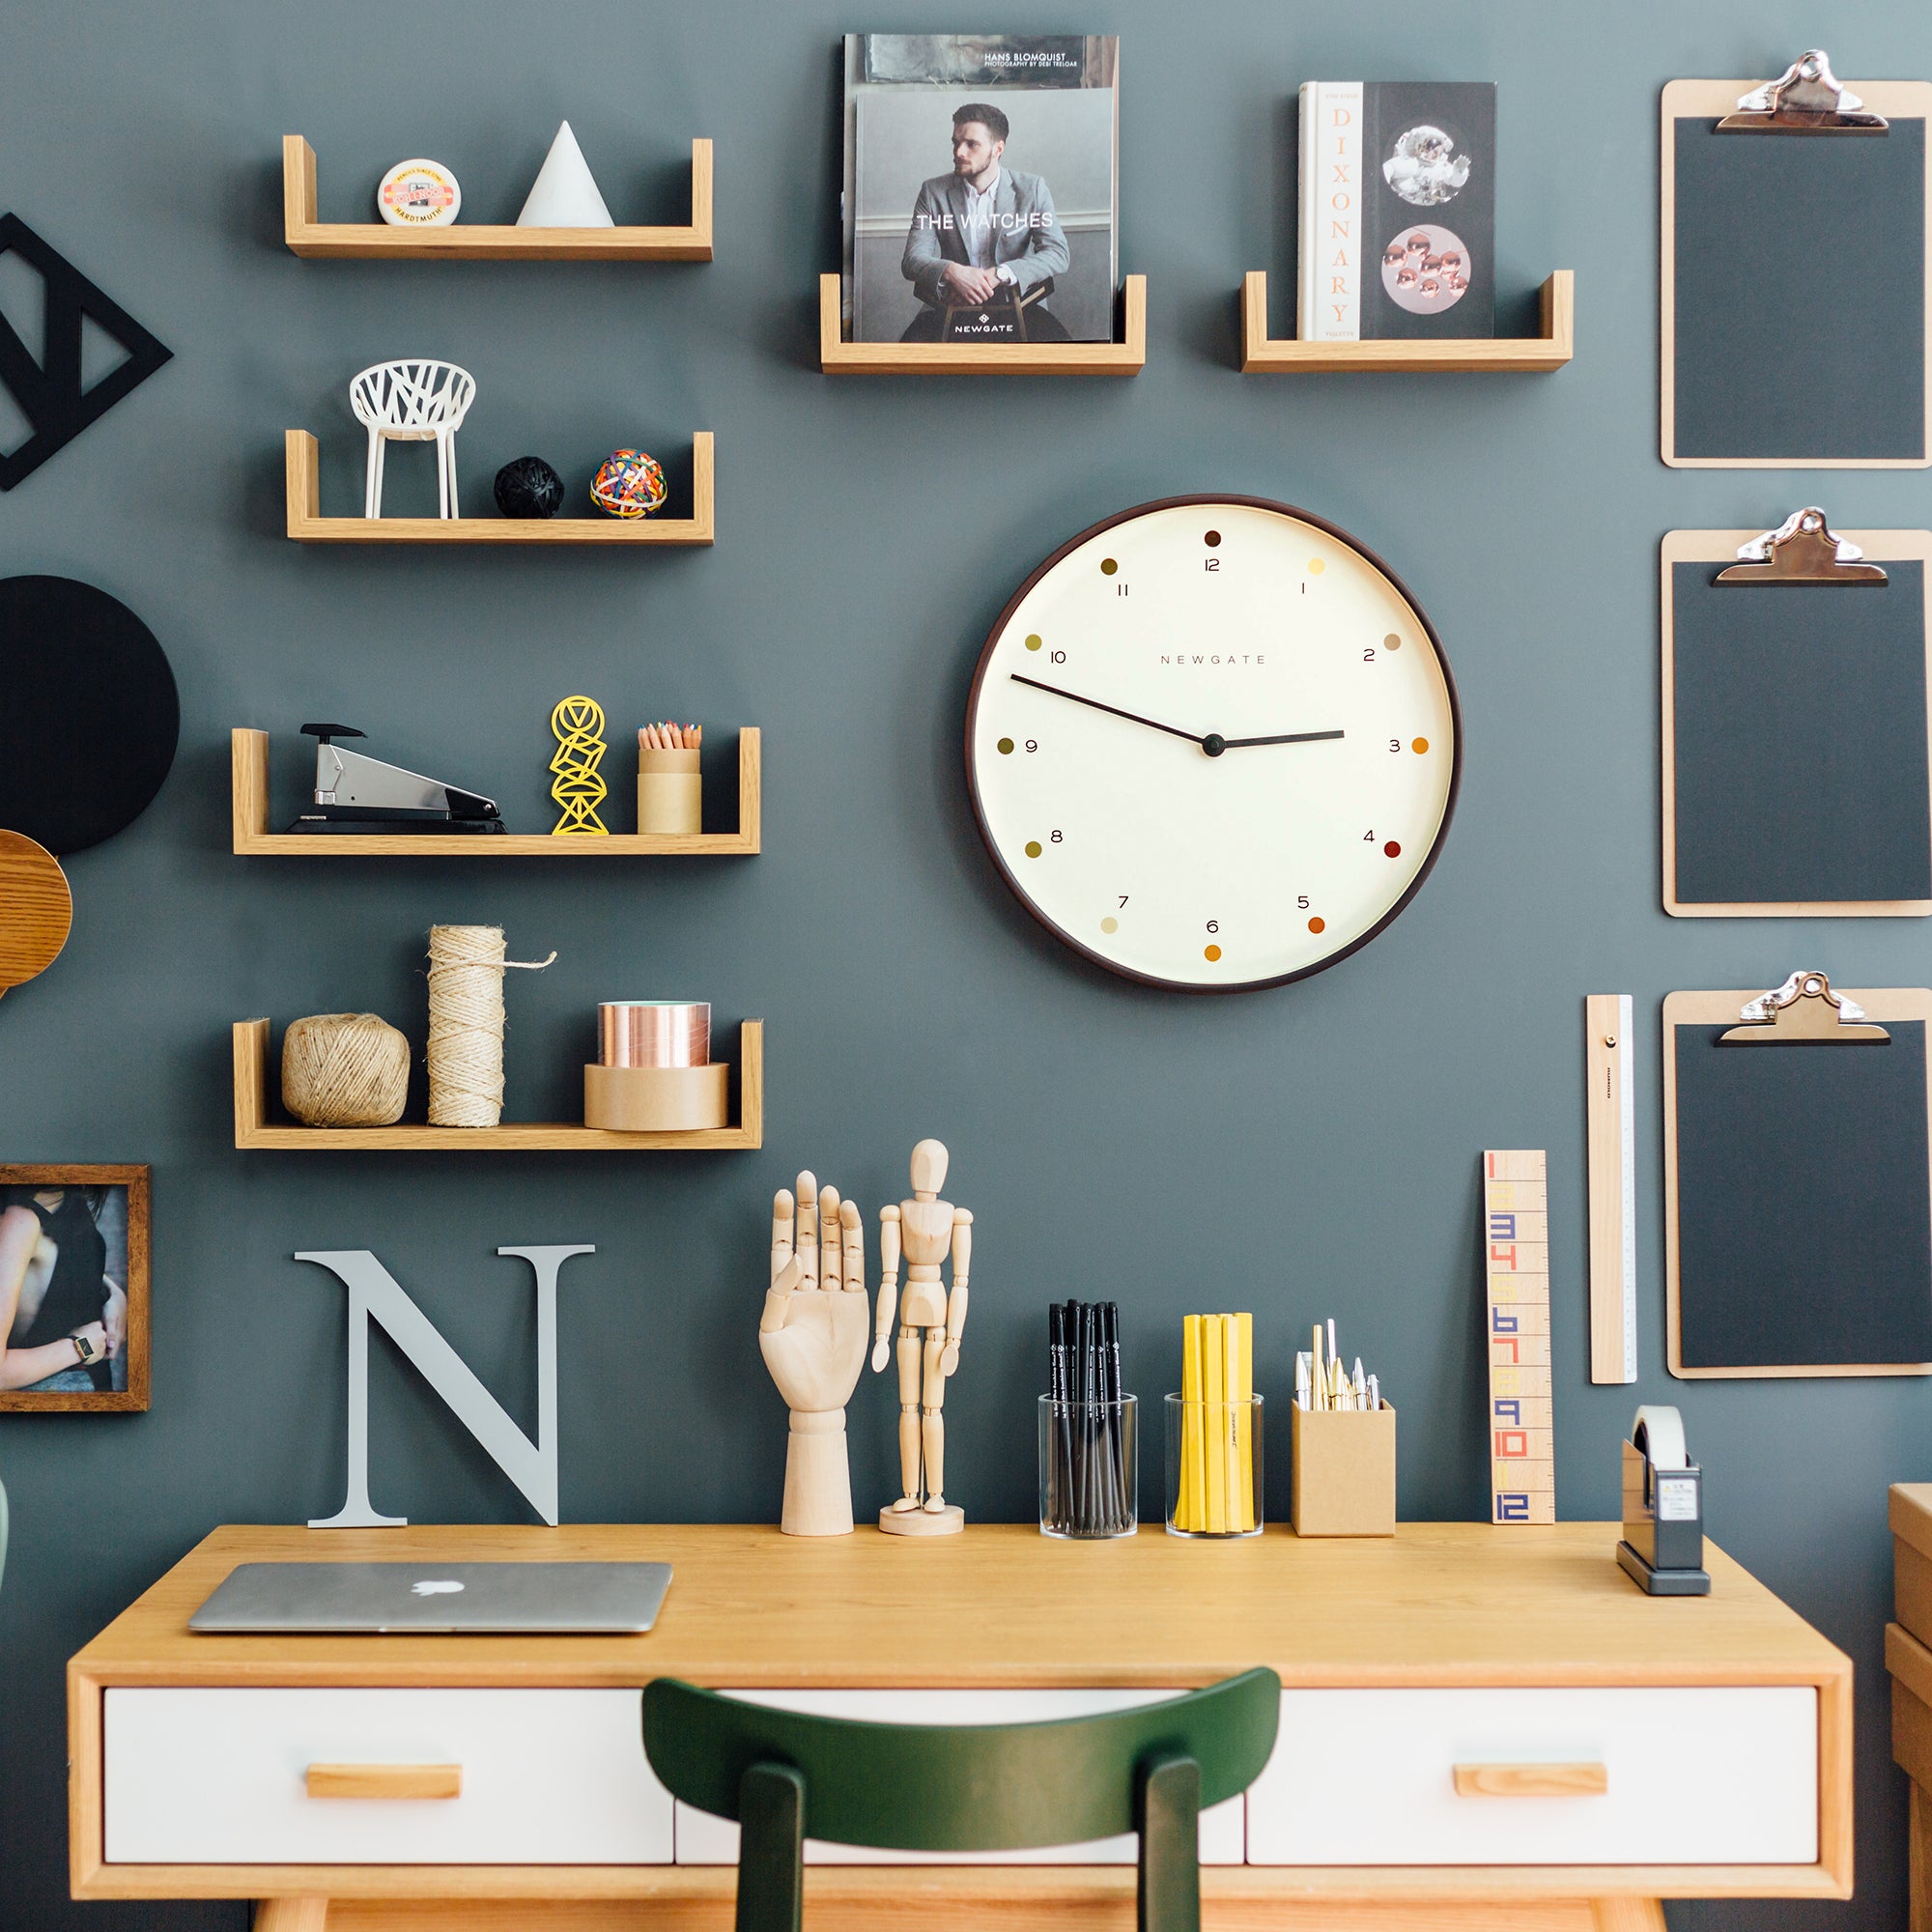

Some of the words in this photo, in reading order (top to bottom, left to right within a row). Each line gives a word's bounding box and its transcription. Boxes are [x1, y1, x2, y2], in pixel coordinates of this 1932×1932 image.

[1013, 53, 1066, 62] BLOMQUIST
[395, 207, 442, 222] HARDTMUTH
[917, 213, 954, 230] THE
[960, 212, 1054, 230] WATCHES
[1330, 108, 1351, 322] DIXONARY
[954, 325, 1013, 333] NEWGATE
[1205, 557, 1220, 572] 12
[1118, 583, 1128, 597] 11
[1050, 650, 1066, 665] 10
[1160, 655, 1266, 665] NEWGATE
[1363, 648, 1376, 662] 2
[1025, 739, 1038, 753] 9
[1388, 739, 1401, 753] 3
[1050, 829, 1064, 843] 8
[1363, 829, 1376, 842] 4
[1118, 895, 1129, 909] 7
[1297, 895, 1310, 910] 5
[1206, 920, 1219, 934] 6
[1490, 1154, 1493, 1178] 1
[1492, 1215, 1515, 1238] 3
[1492, 1246, 1516, 1269] 4
[1493, 1308, 1518, 1331] 6
[1493, 1339, 1519, 1363] 7
[294, 1243, 596, 1528] N
[1495, 1401, 1520, 1424] 9
[1495, 1432, 1527, 1457] 10
[1497, 1495, 1528, 1520] 12
